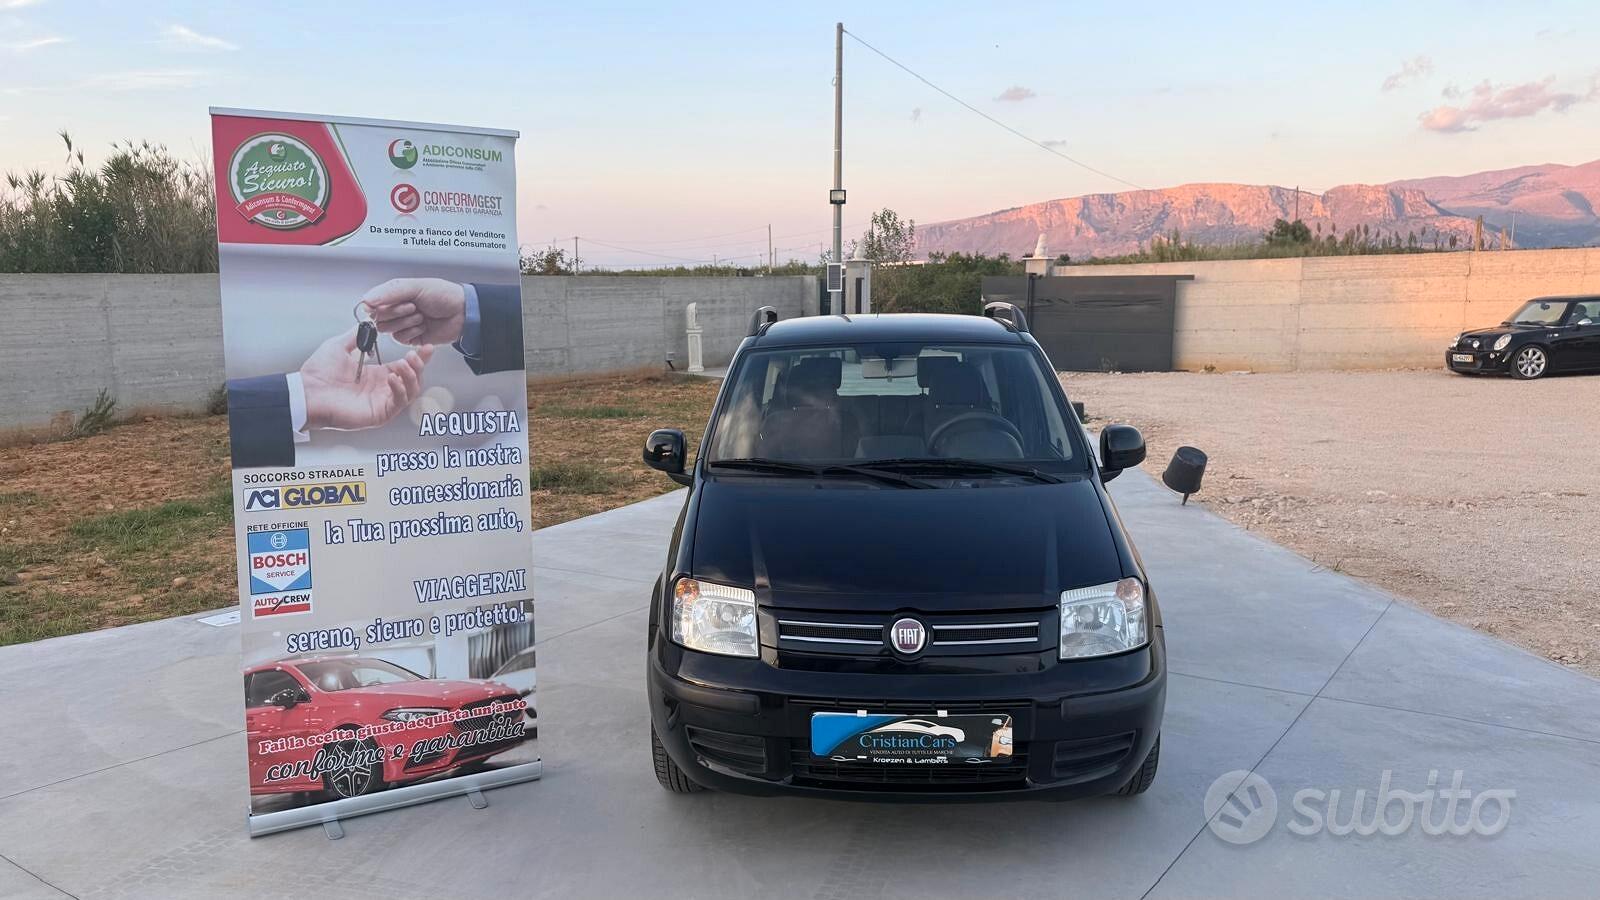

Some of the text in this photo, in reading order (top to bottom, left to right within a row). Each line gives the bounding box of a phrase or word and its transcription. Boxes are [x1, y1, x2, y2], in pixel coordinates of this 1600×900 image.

[422, 144, 503, 162] ADICONSUM
[244, 160, 306, 178] Acquisto
[243, 168, 315, 193] Sicuro!
[424, 190, 503, 210] CONFORMGEST
[424, 205, 440, 213] UNA
[441, 206, 464, 214] SCELTA
[370, 225, 382, 234] Da
[384, 227, 417, 237] sempre
[426, 227, 453, 237] fianco
[454, 229, 467, 237] del
[469, 230, 506, 239] Venditore
[411, 236, 436, 246] Tutela
[438, 238, 452, 247] del
[453, 238, 507, 250] Consumatore
[419, 411, 521, 437] ACQUISTA
[376, 443, 521, 477] presso la nostra
[243, 468, 365, 484] SOCCORSO STRADALE
[245, 484, 365, 510] ACI GLOBAL
[389, 474, 523, 506] concessionaria
[247, 520, 309, 532] RETE OFFICINE
[324, 507, 524, 545] la Tua prossima auto,
[253, 552, 307, 570] BOSCH
[266, 570, 296, 579] SERVICE
[414, 569, 527, 603] VIAGGERAI
[286, 601, 527, 653] sereno, sicuro e protetto!
[899, 628, 919, 645] FIAT
[259, 699, 528, 755] Fai la scelta giusta acquista un'auto
[263, 716, 526, 783] conforme e garantita
[859, 734, 956, 748] CristianCars
